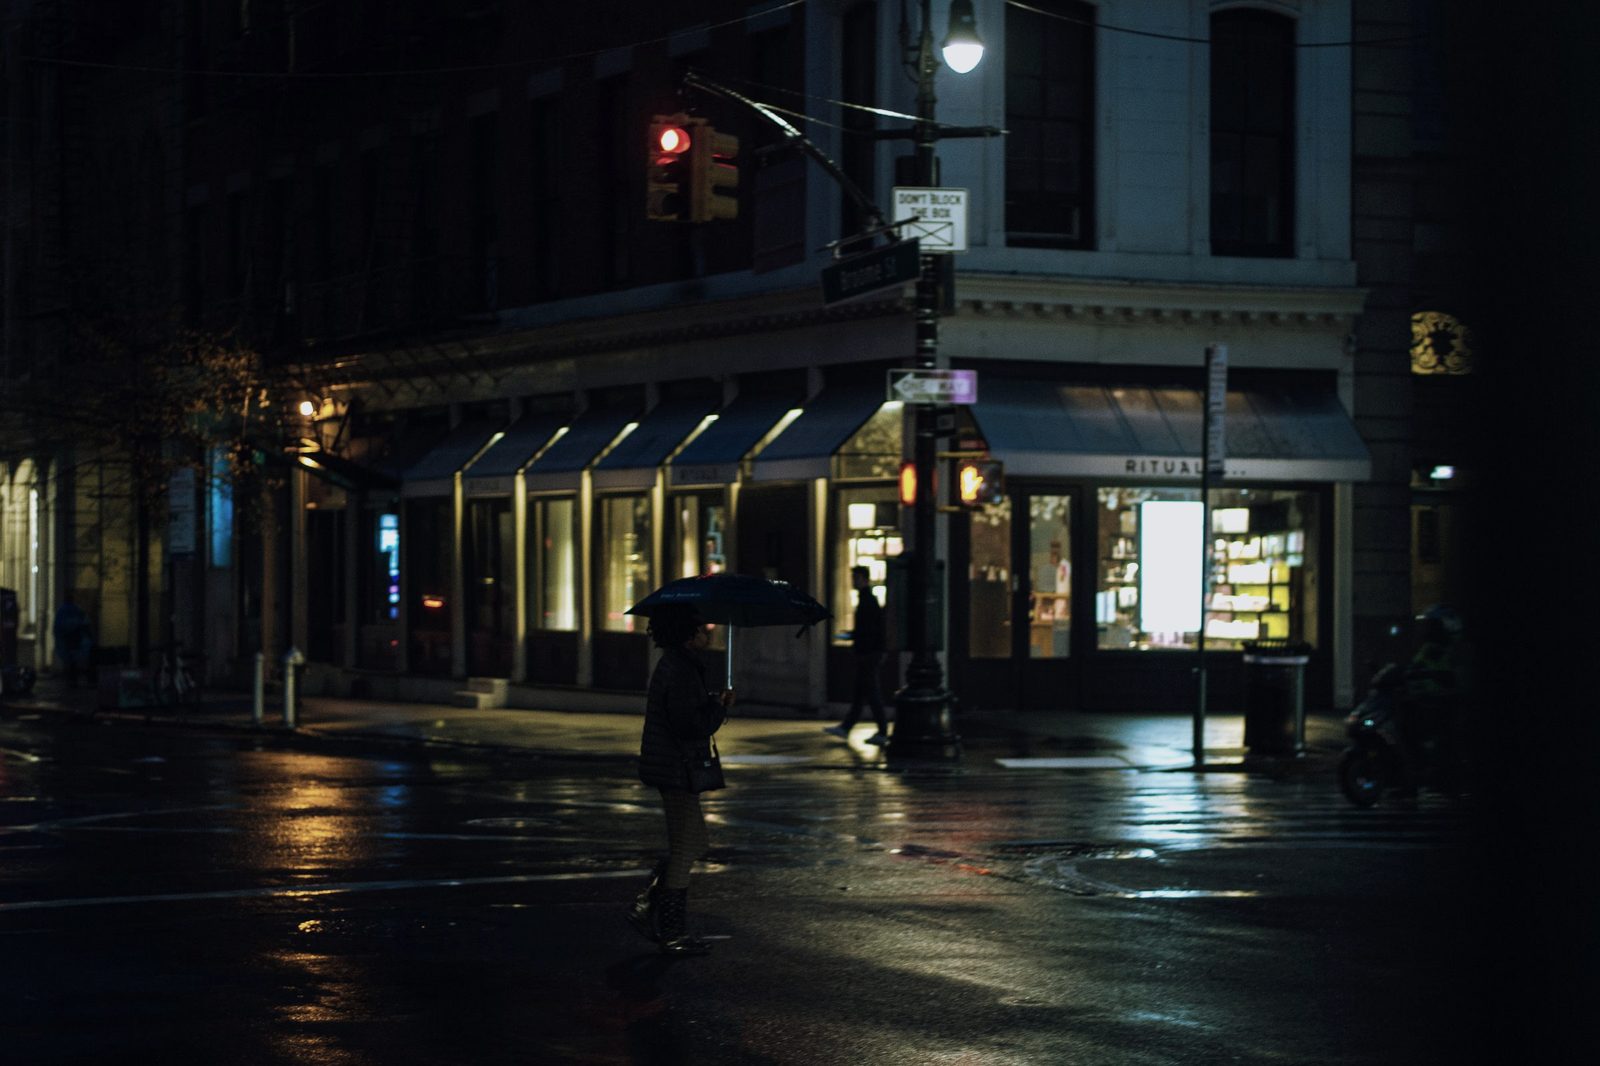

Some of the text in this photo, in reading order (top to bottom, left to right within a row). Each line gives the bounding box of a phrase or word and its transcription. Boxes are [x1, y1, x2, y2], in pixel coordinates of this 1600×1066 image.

[898, 193, 961, 205] DON'T BLOCK
[910, 207, 951, 218] THE BOX
[902, 380, 963, 392] ONE WAY
